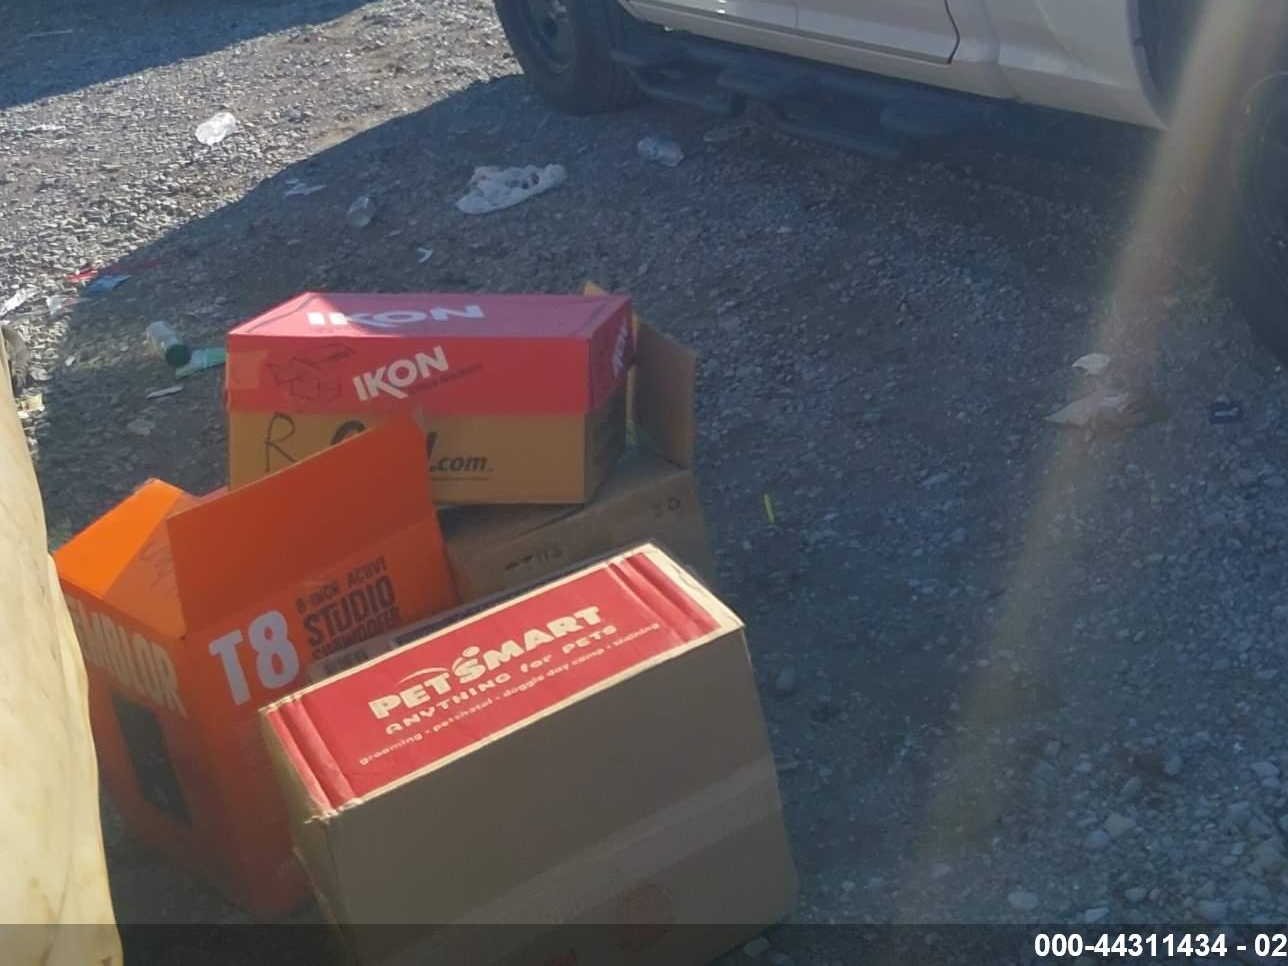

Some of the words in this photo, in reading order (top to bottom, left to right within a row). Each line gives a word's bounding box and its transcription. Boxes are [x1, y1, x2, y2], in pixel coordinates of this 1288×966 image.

[307, 305, 485, 327] IKON
[352, 346, 449, 402] IKON
[303, 575, 396, 646] STUDIO
[208, 610, 299, 706] T8
[359, 732, 423, 765] grooming
[503, 675, 545, 698] doggie
[547, 663, 570, 677] day
[571, 647, 604, 667] camp
[613, 622, 661, 647] training
[386, 672, 512, 735] ANYTHING
[520, 654, 553, 673] for
[562, 624, 617, 654] PETS
